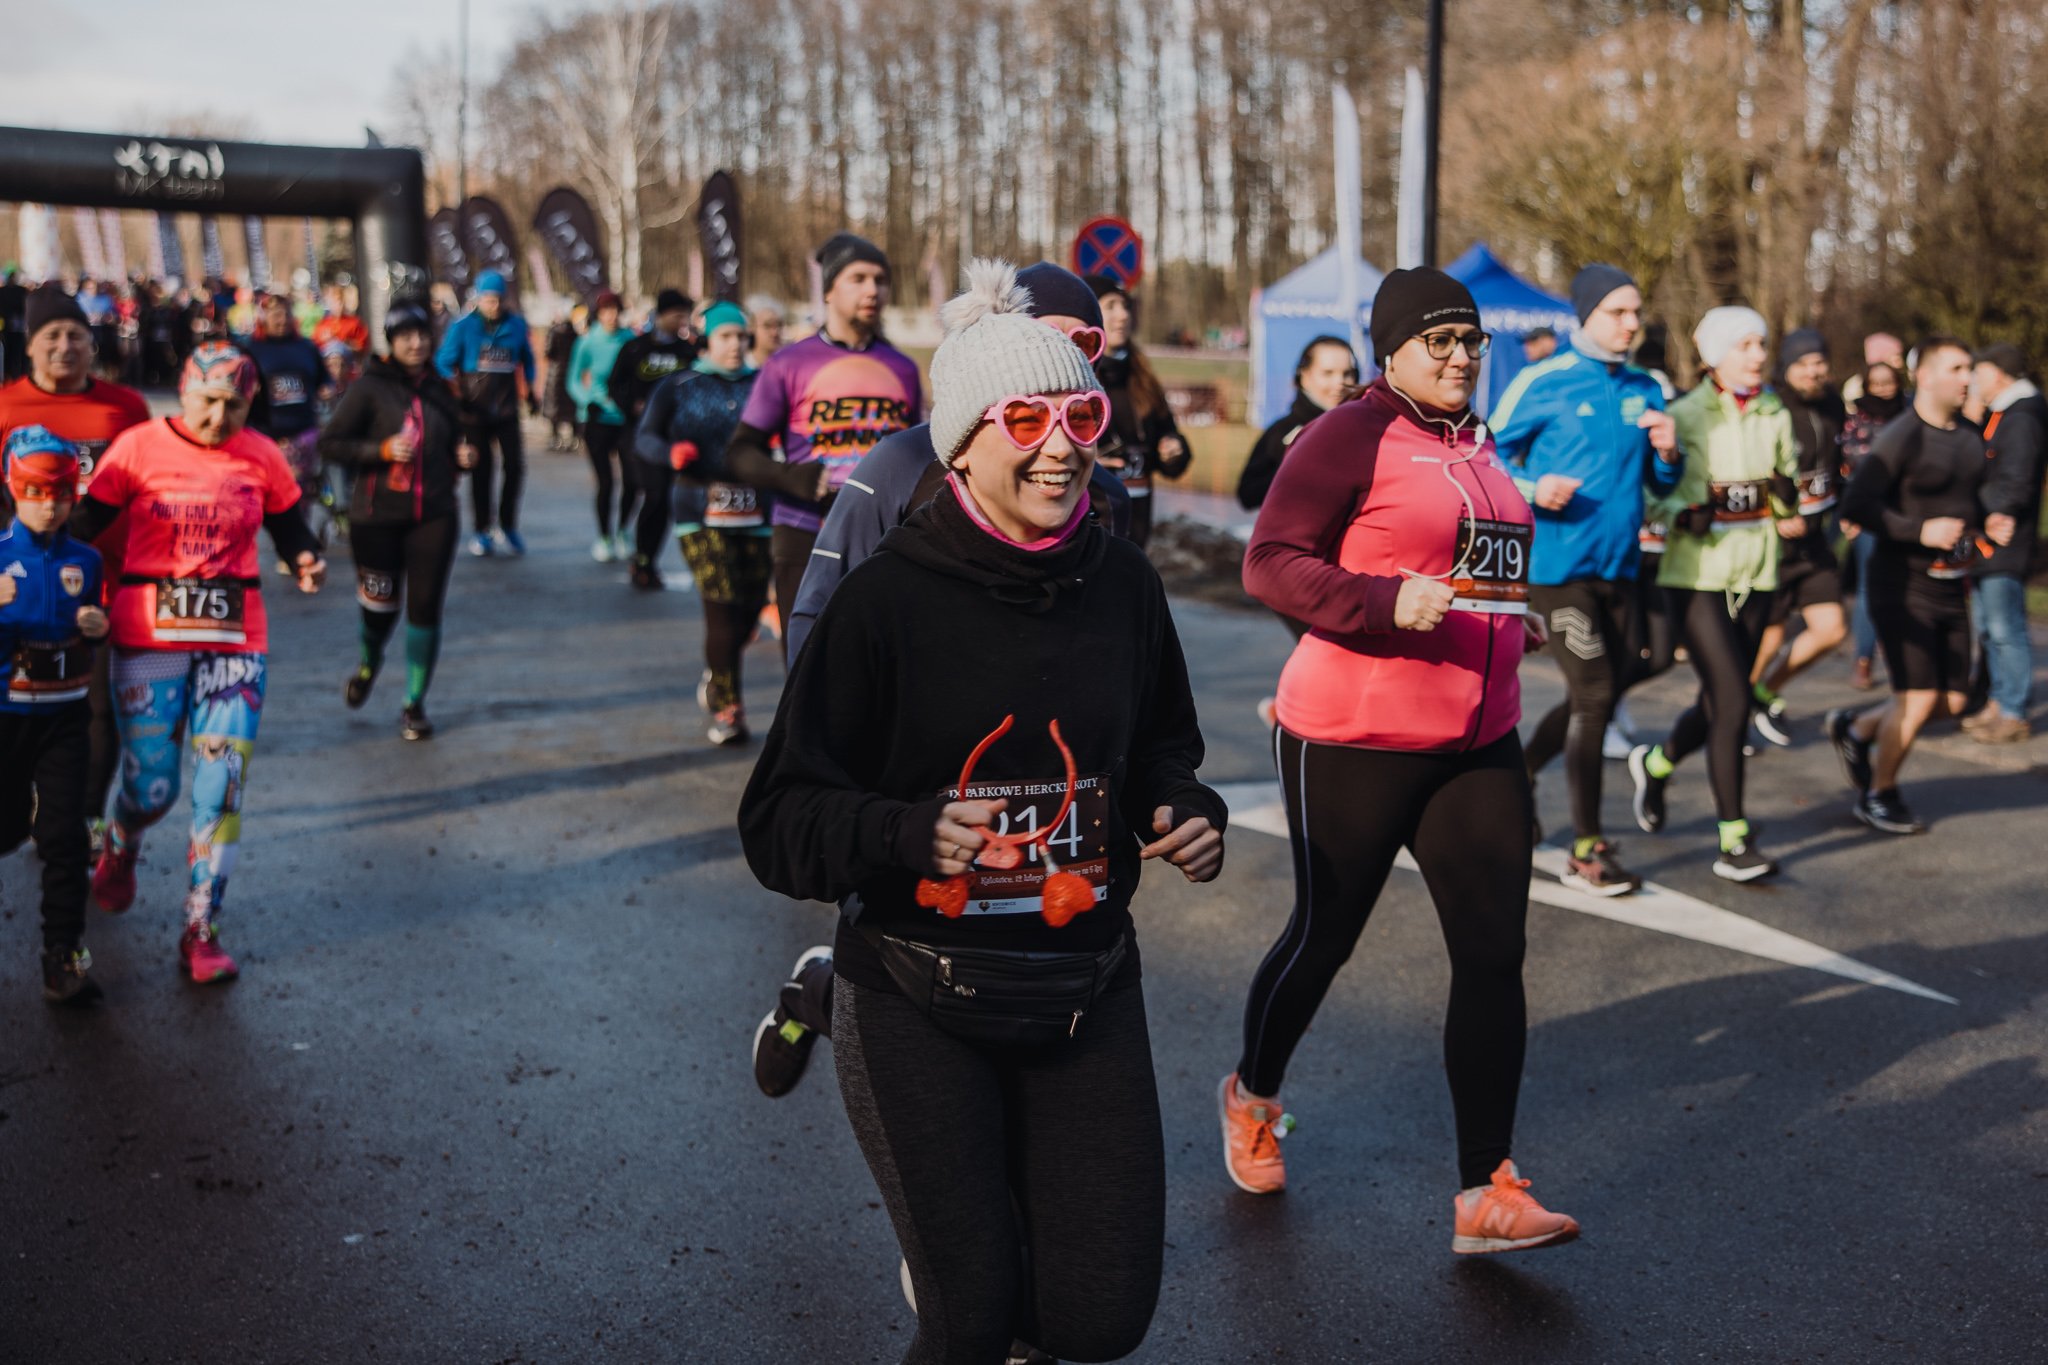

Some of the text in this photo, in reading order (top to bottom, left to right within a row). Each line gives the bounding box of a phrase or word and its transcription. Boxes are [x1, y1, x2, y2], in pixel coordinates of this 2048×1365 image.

[1471, 535, 1524, 580] 219
[171, 586, 229, 619] 175
[53, 651, 66, 680] 1
[965, 785, 1022, 798] PARKOWE
[1025, 778, 1098, 795] HERCKLKOTY
